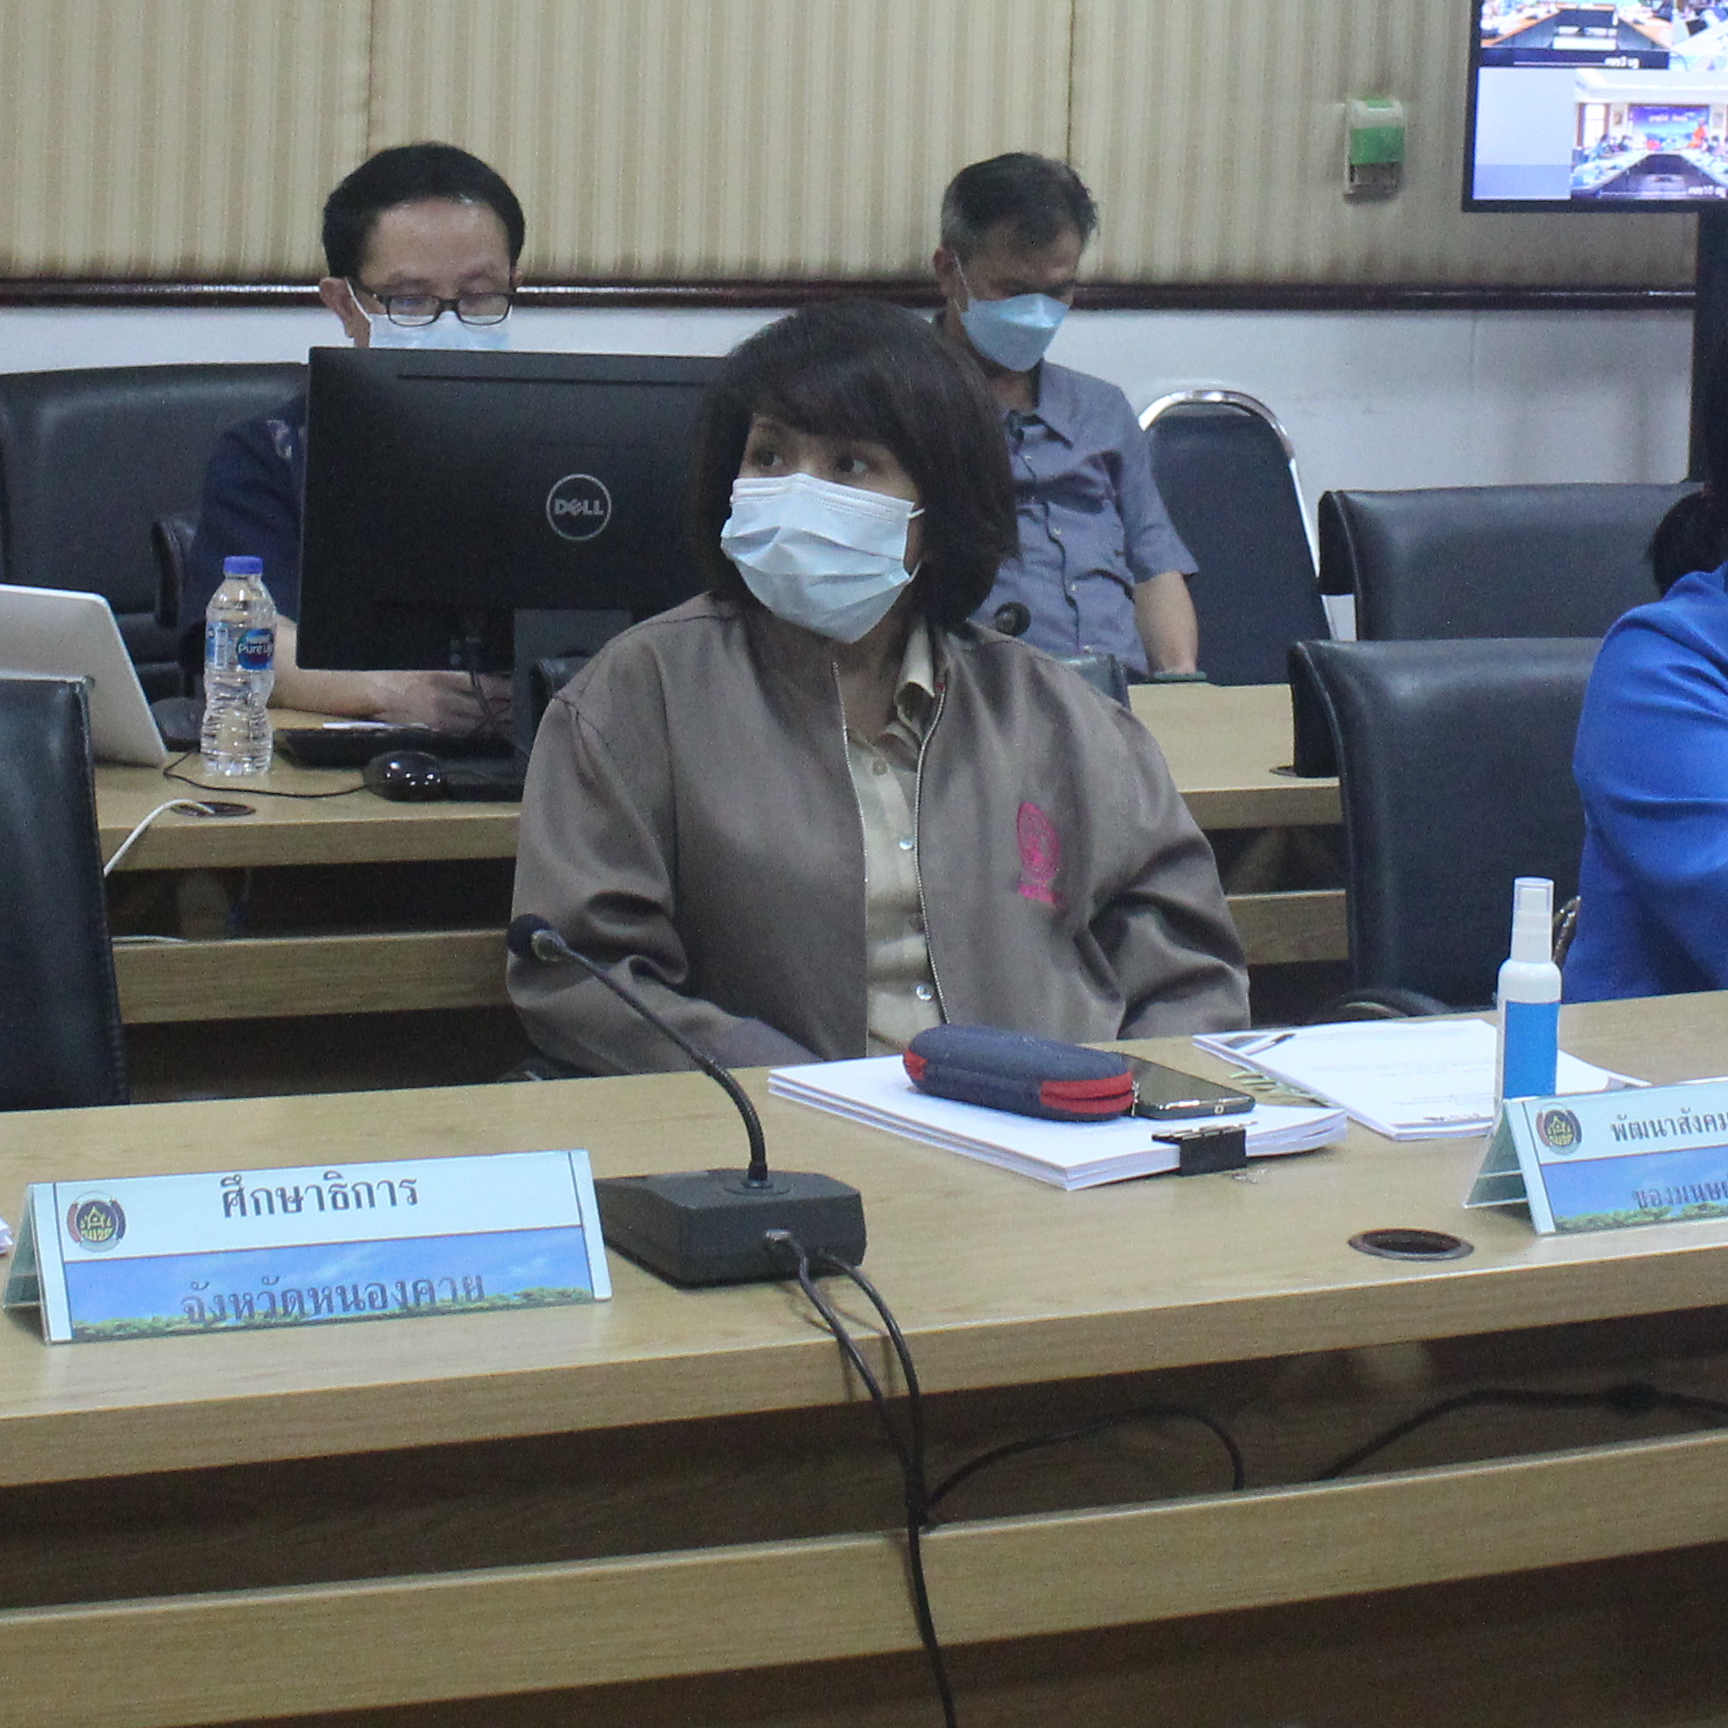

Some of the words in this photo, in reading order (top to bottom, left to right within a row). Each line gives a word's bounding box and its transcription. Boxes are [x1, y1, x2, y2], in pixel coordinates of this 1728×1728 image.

[553, 497, 605, 517] DELL
[220, 1172, 420, 1218] ศึกษาธิการ
[180, 1271, 487, 1326] จังหวัดหนองคาย
